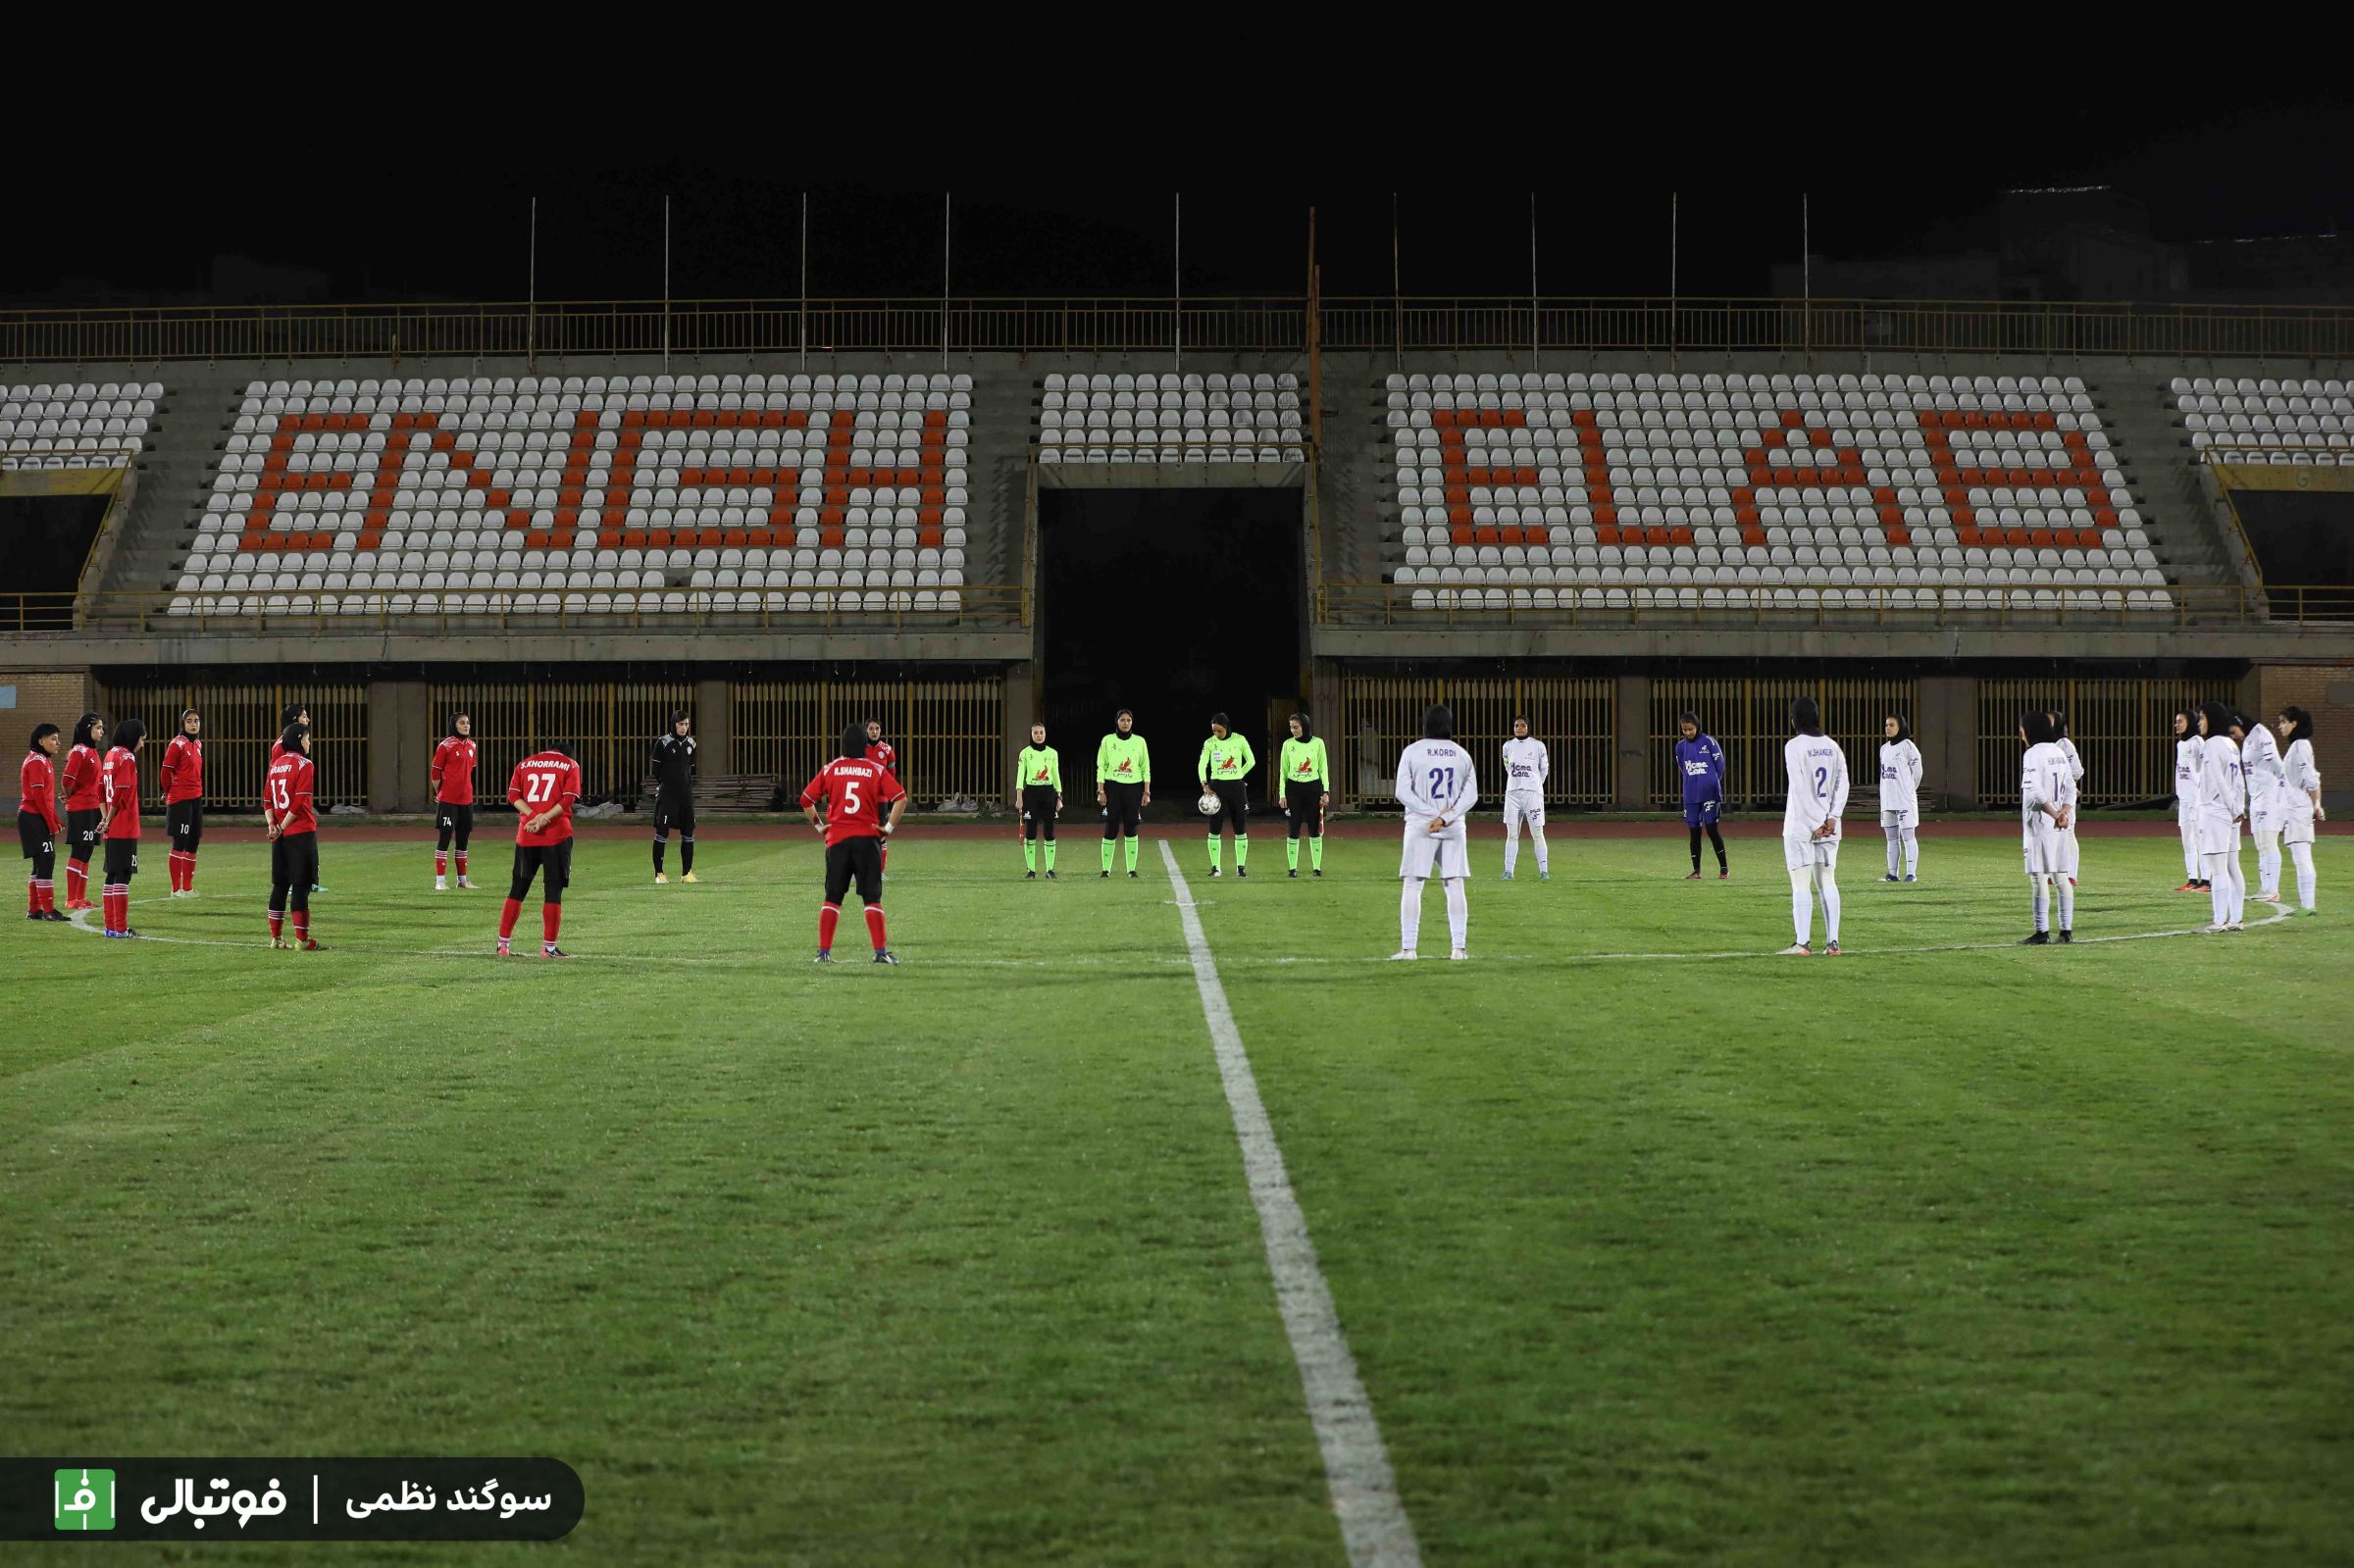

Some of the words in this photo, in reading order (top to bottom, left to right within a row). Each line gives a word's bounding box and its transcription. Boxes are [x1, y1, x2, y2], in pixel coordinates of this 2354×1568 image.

[270, 778, 290, 810] 13
[527, 773, 556, 802] 27
[1428, 767, 1455, 799] 21
[1815, 767, 1827, 798] 2
[844, 781, 860, 815] 5
[82, 830, 94, 841] 20
[179, 823, 190, 835] 10
[42, 840, 55, 853] 21
